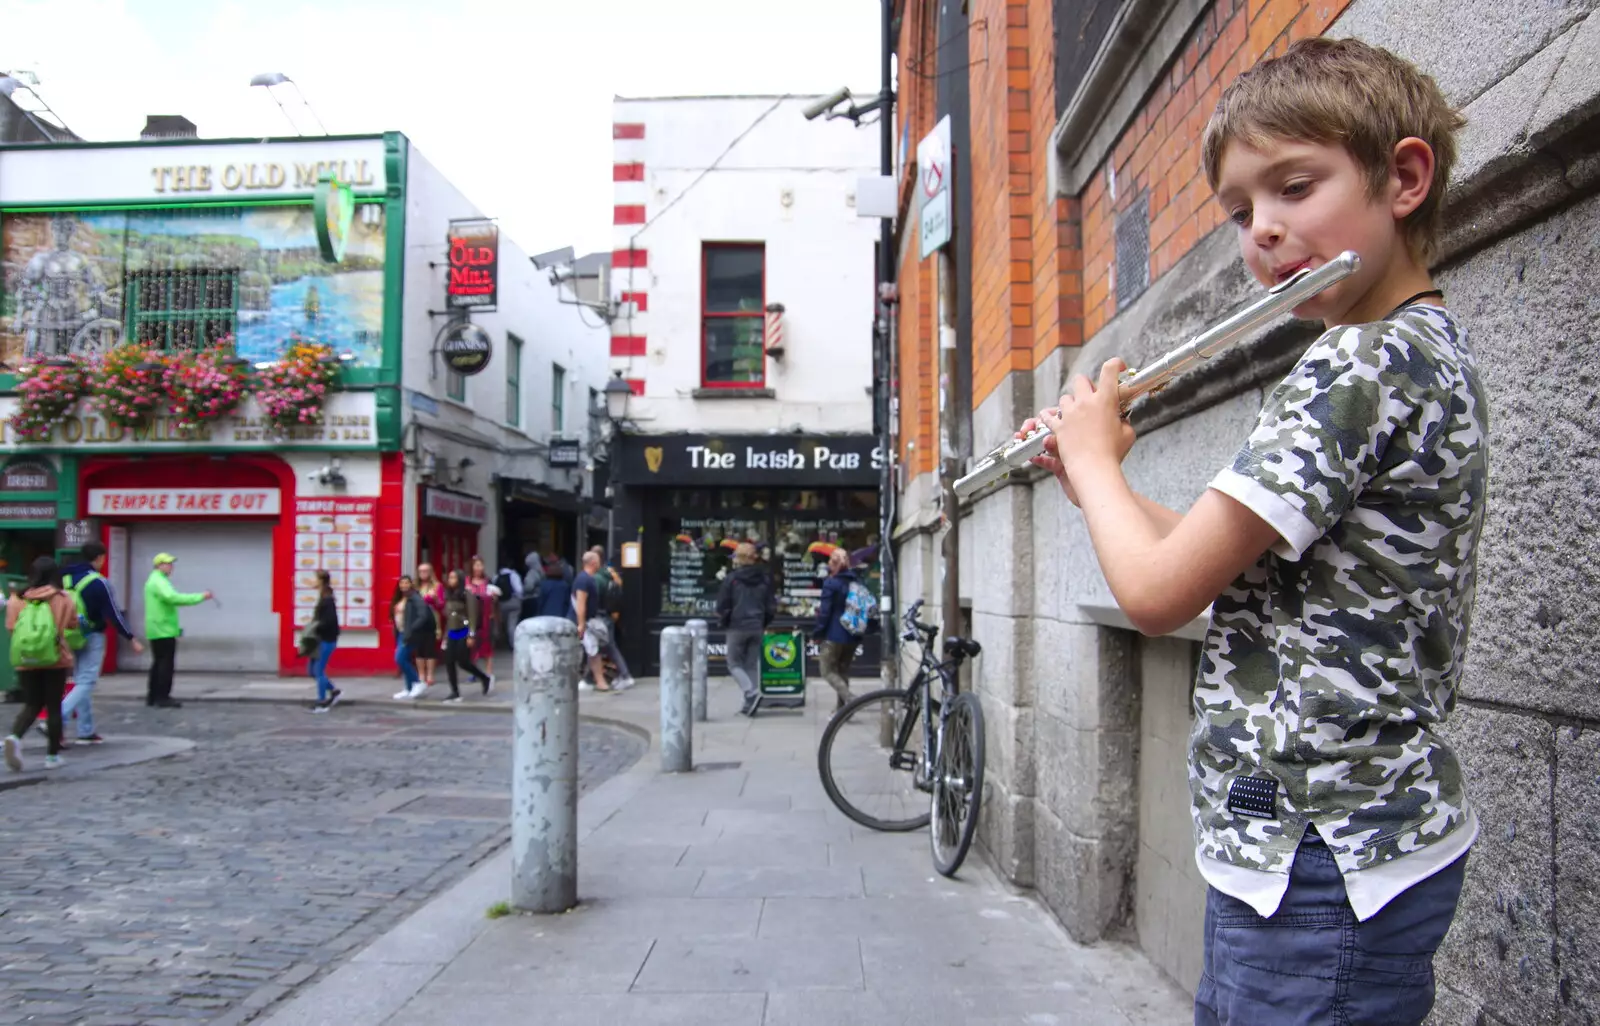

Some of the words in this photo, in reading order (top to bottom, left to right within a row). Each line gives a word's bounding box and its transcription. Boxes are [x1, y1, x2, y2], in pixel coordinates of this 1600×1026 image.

[152, 165, 212, 193] THE
[221, 162, 286, 191] OLD
[450, 245, 495, 267] OLD
[686, 447, 735, 469] The
[746, 446, 805, 469] Irish
[813, 446, 860, 469] Pub
[102, 494, 169, 511] TEMPLE
[175, 494, 222, 511] TAKE
[229, 493, 268, 510] OUT
